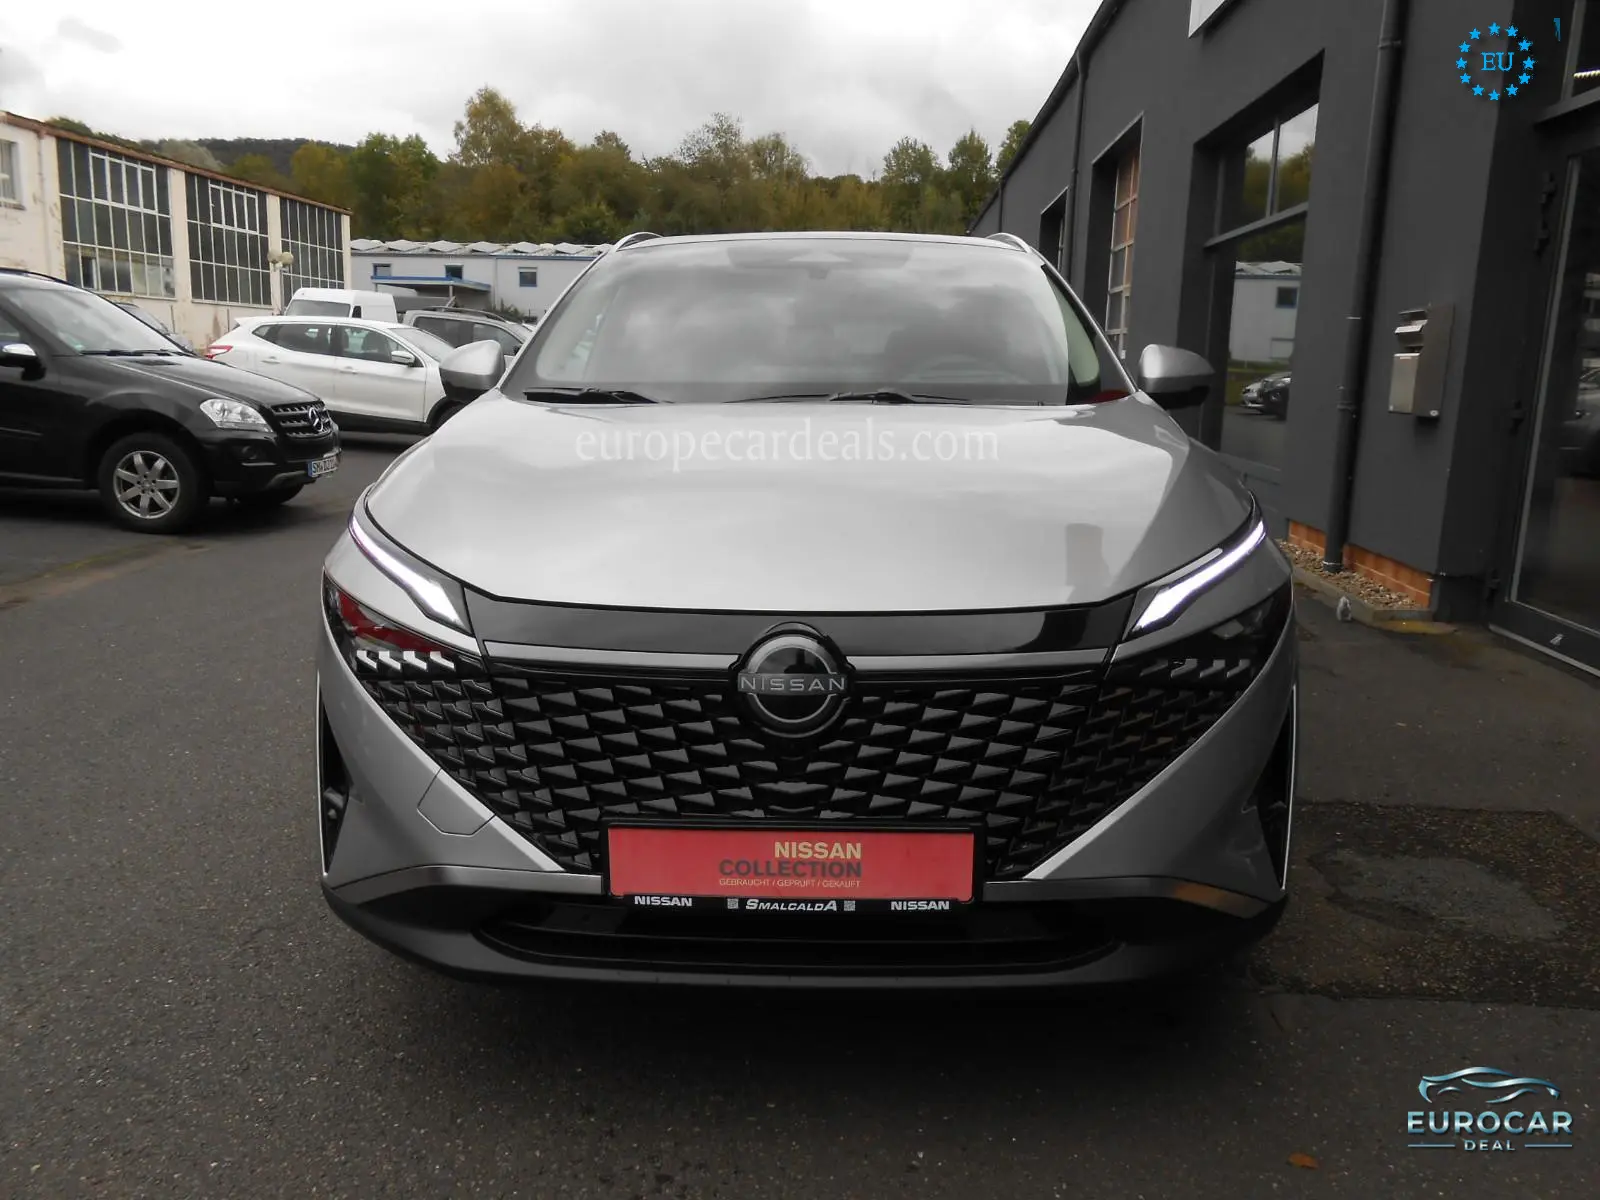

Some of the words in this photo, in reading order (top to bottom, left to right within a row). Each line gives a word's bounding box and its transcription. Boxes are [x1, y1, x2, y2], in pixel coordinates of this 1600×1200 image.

[741, 677, 845, 691] NISSAN
[774, 841, 862, 859] NISSAN
[719, 859, 862, 878] COLLECTION
[719, 878, 770, 887] GEBRAUCHT
[634, 895, 693, 907] NISSAN
[890, 901, 950, 910] NISSAN
